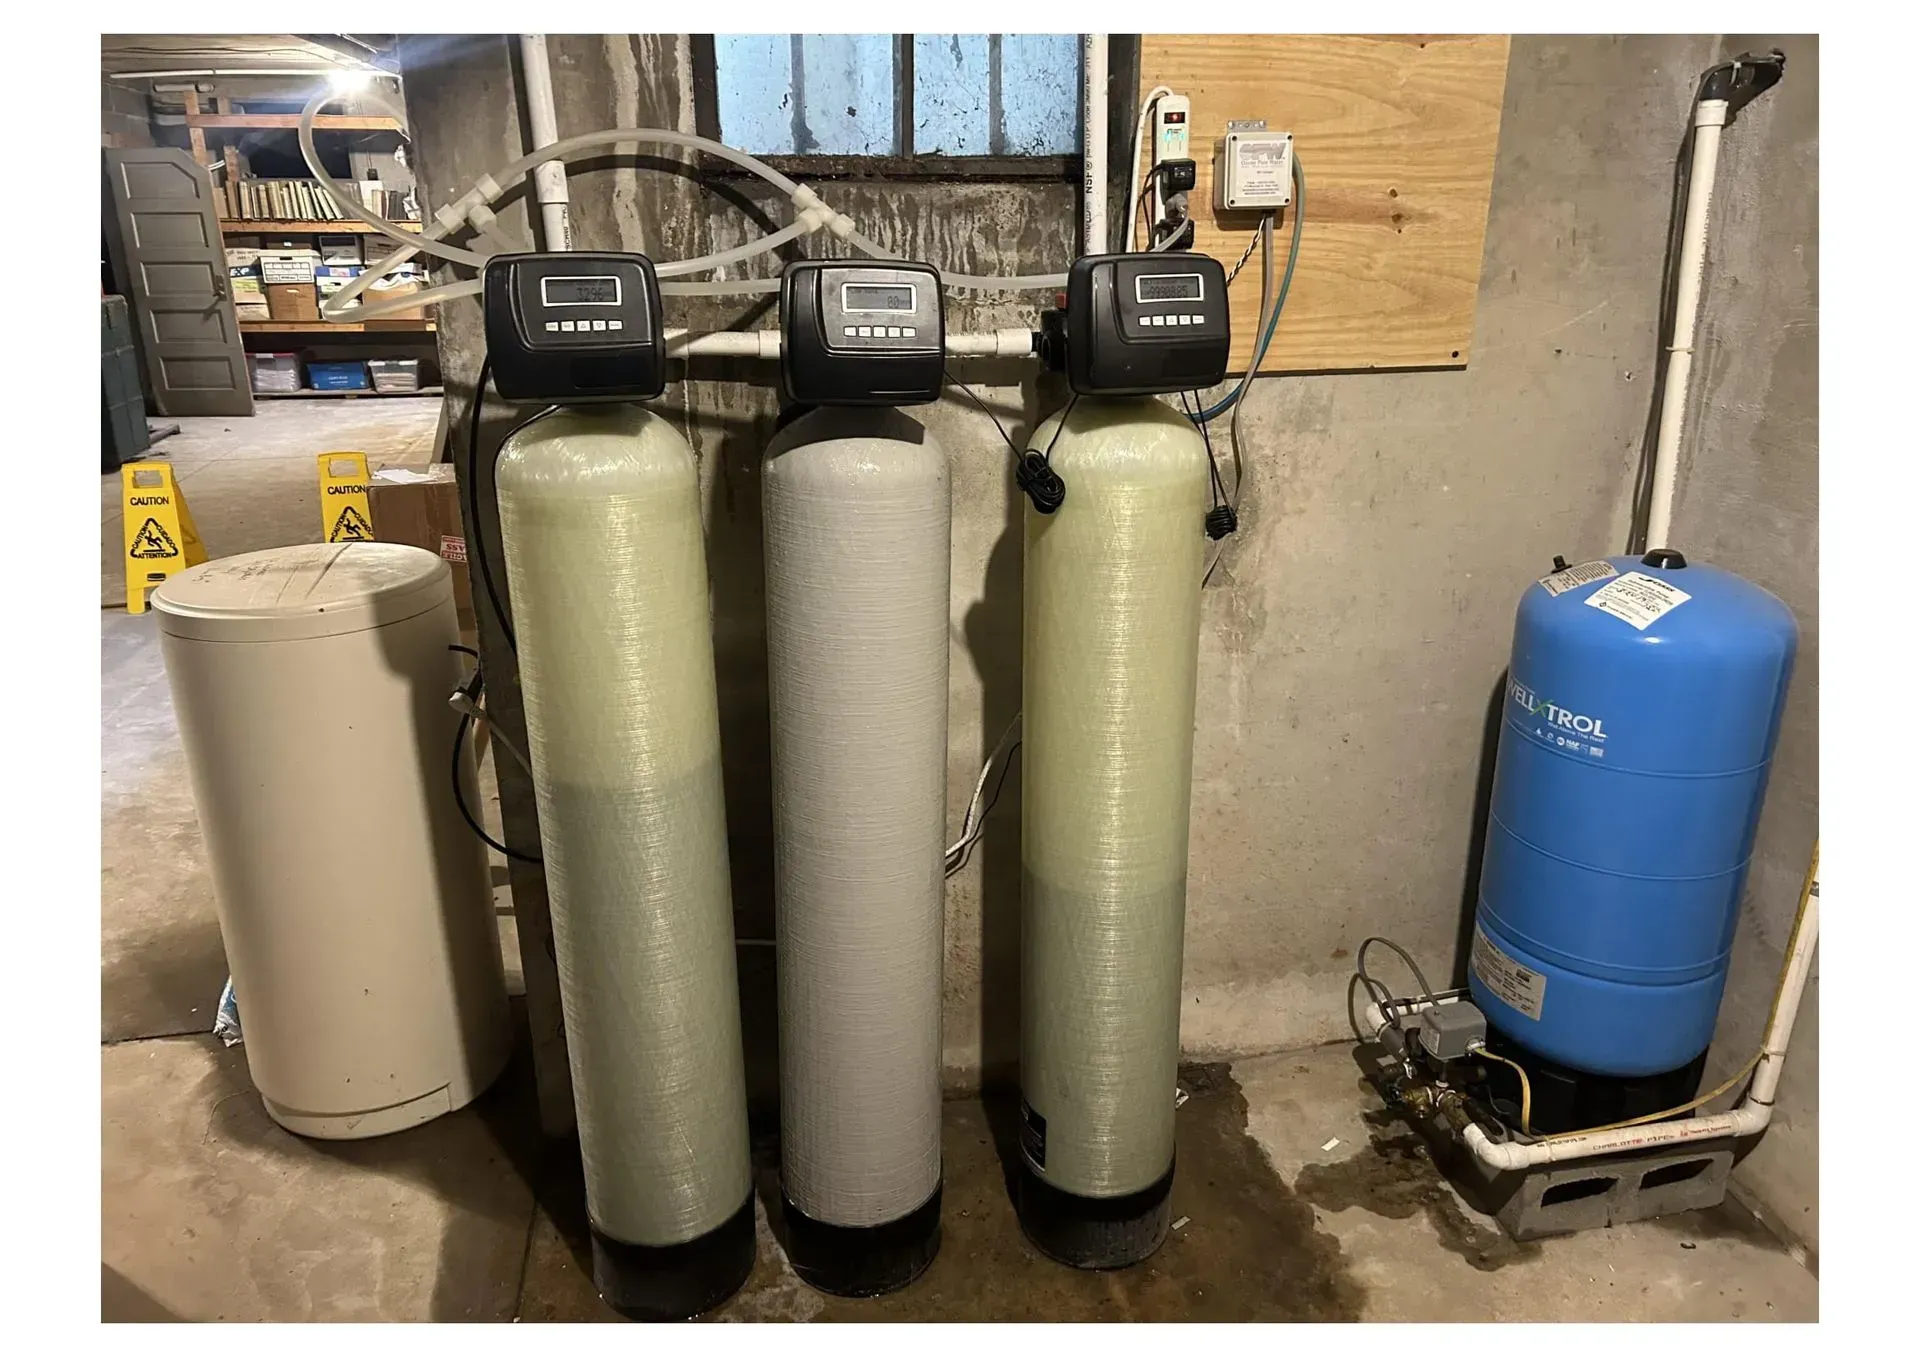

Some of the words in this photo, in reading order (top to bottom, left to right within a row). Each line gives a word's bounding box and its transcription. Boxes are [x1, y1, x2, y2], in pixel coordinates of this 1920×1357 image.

[327, 485, 366, 495] CAUTION
[130, 496, 170, 506] CAUTION
[136, 552, 172, 560] ATTENTION
